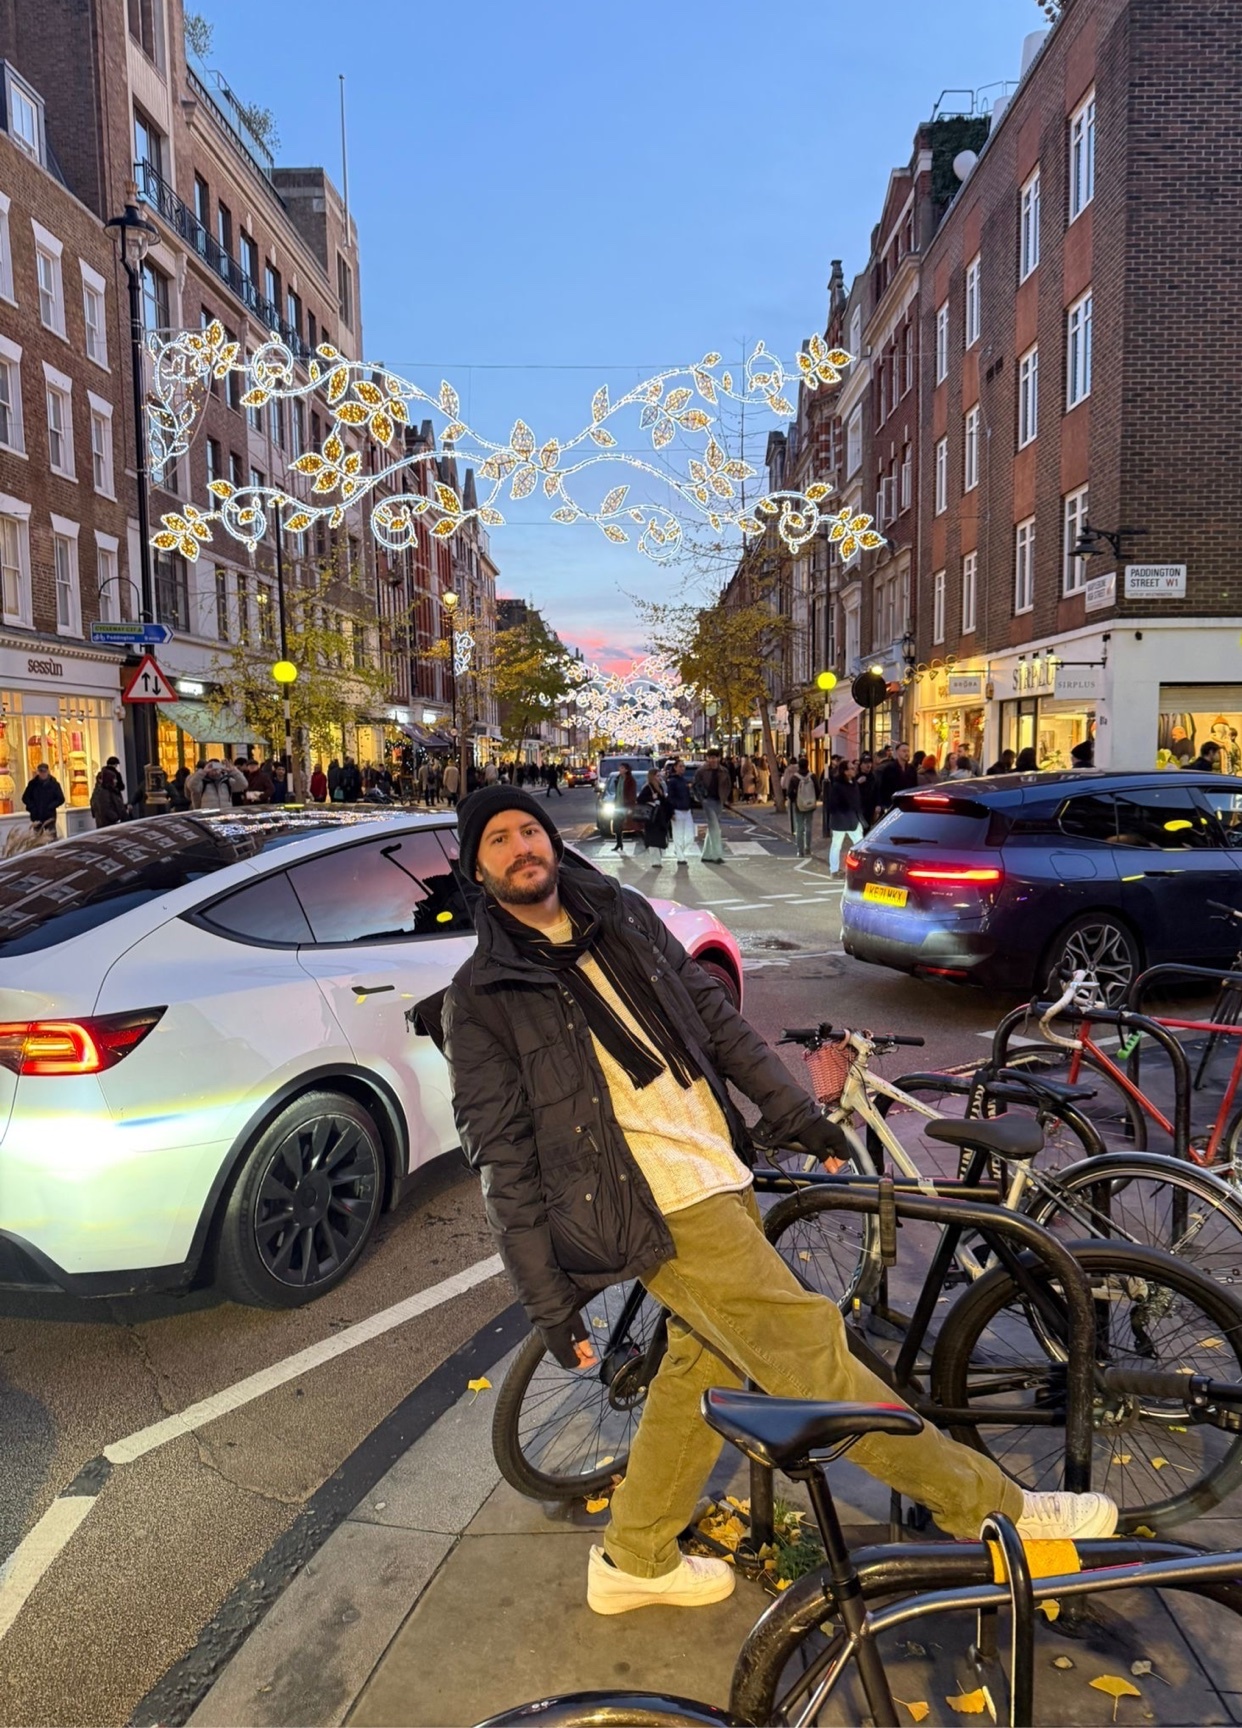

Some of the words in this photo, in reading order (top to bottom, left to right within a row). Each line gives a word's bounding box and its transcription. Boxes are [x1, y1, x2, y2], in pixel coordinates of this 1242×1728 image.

[1130, 568, 1180, 577] PADDINGTON
[1130, 578, 1159, 587] STREET
[1166, 578, 1178, 587] W1
[28, 657, 63, 676] sessùn
[1013, 662, 1054, 690] SIRPLU
[1057, 681, 1096, 689] SIRPLUS
